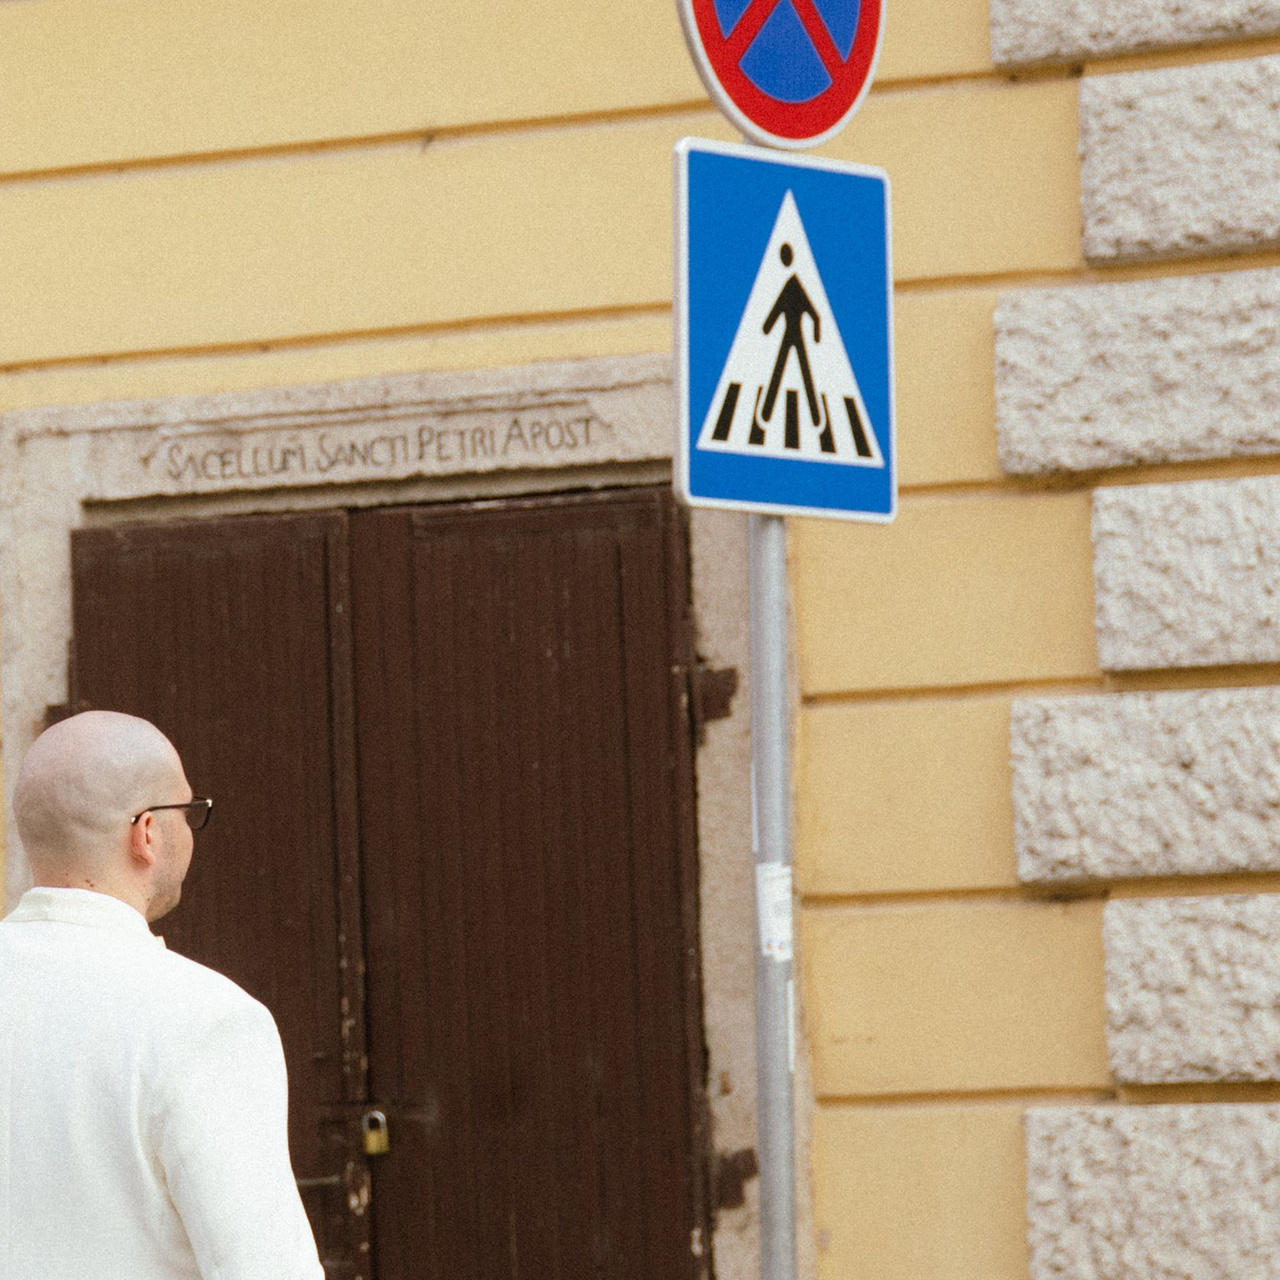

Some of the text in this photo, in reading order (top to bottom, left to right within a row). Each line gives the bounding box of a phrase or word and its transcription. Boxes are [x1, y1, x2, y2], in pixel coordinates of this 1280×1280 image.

[316, 433, 409, 474] SANCTI
[418, 424, 496, 462] PETRI
[503, 417, 598, 455] APOST
